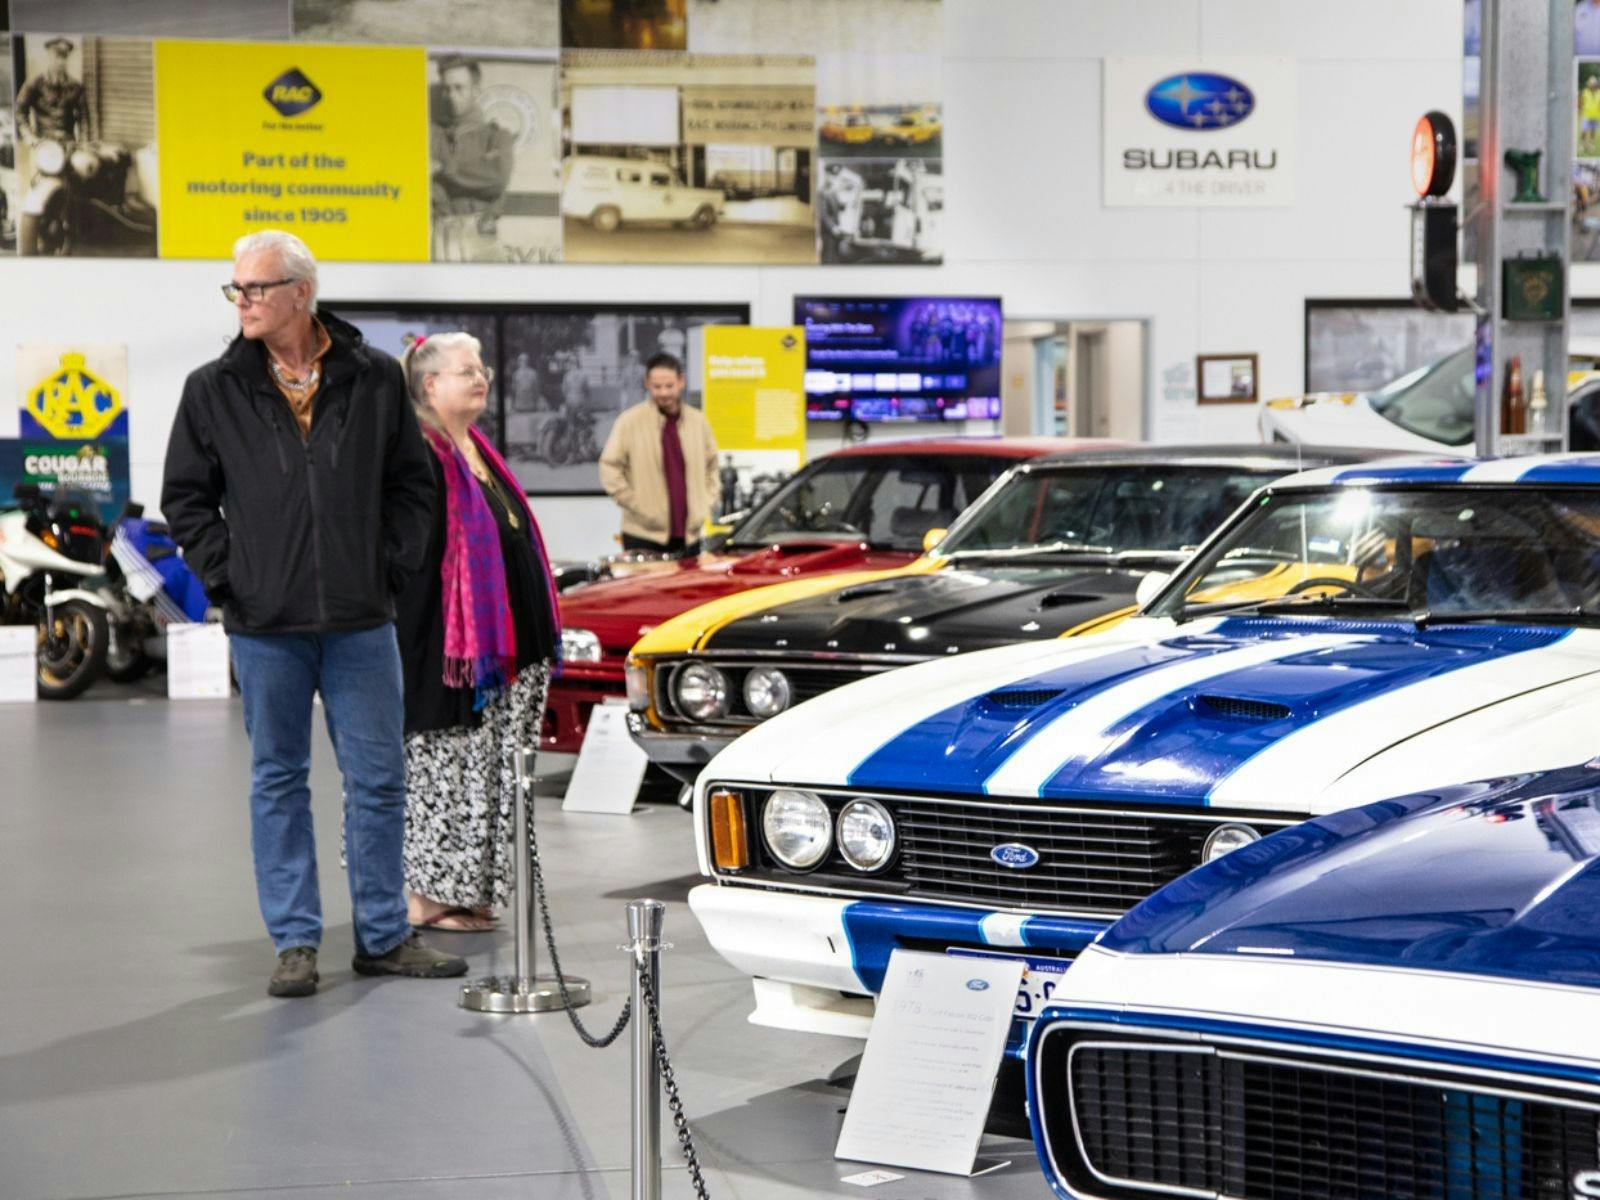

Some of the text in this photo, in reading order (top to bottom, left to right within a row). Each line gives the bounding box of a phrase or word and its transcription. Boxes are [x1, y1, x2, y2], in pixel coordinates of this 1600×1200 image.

[271, 86, 314, 103] RAC
[242, 151, 346, 170] Part of the
[1123, 148, 1277, 170] SUBARU
[187, 179, 401, 201] motoring community
[243, 206, 348, 223] since 1905
[25, 455, 107, 474] COUGAR
[1001, 847, 1028, 862] Ford
[1036, 964, 1067, 973] AUSTRALI
